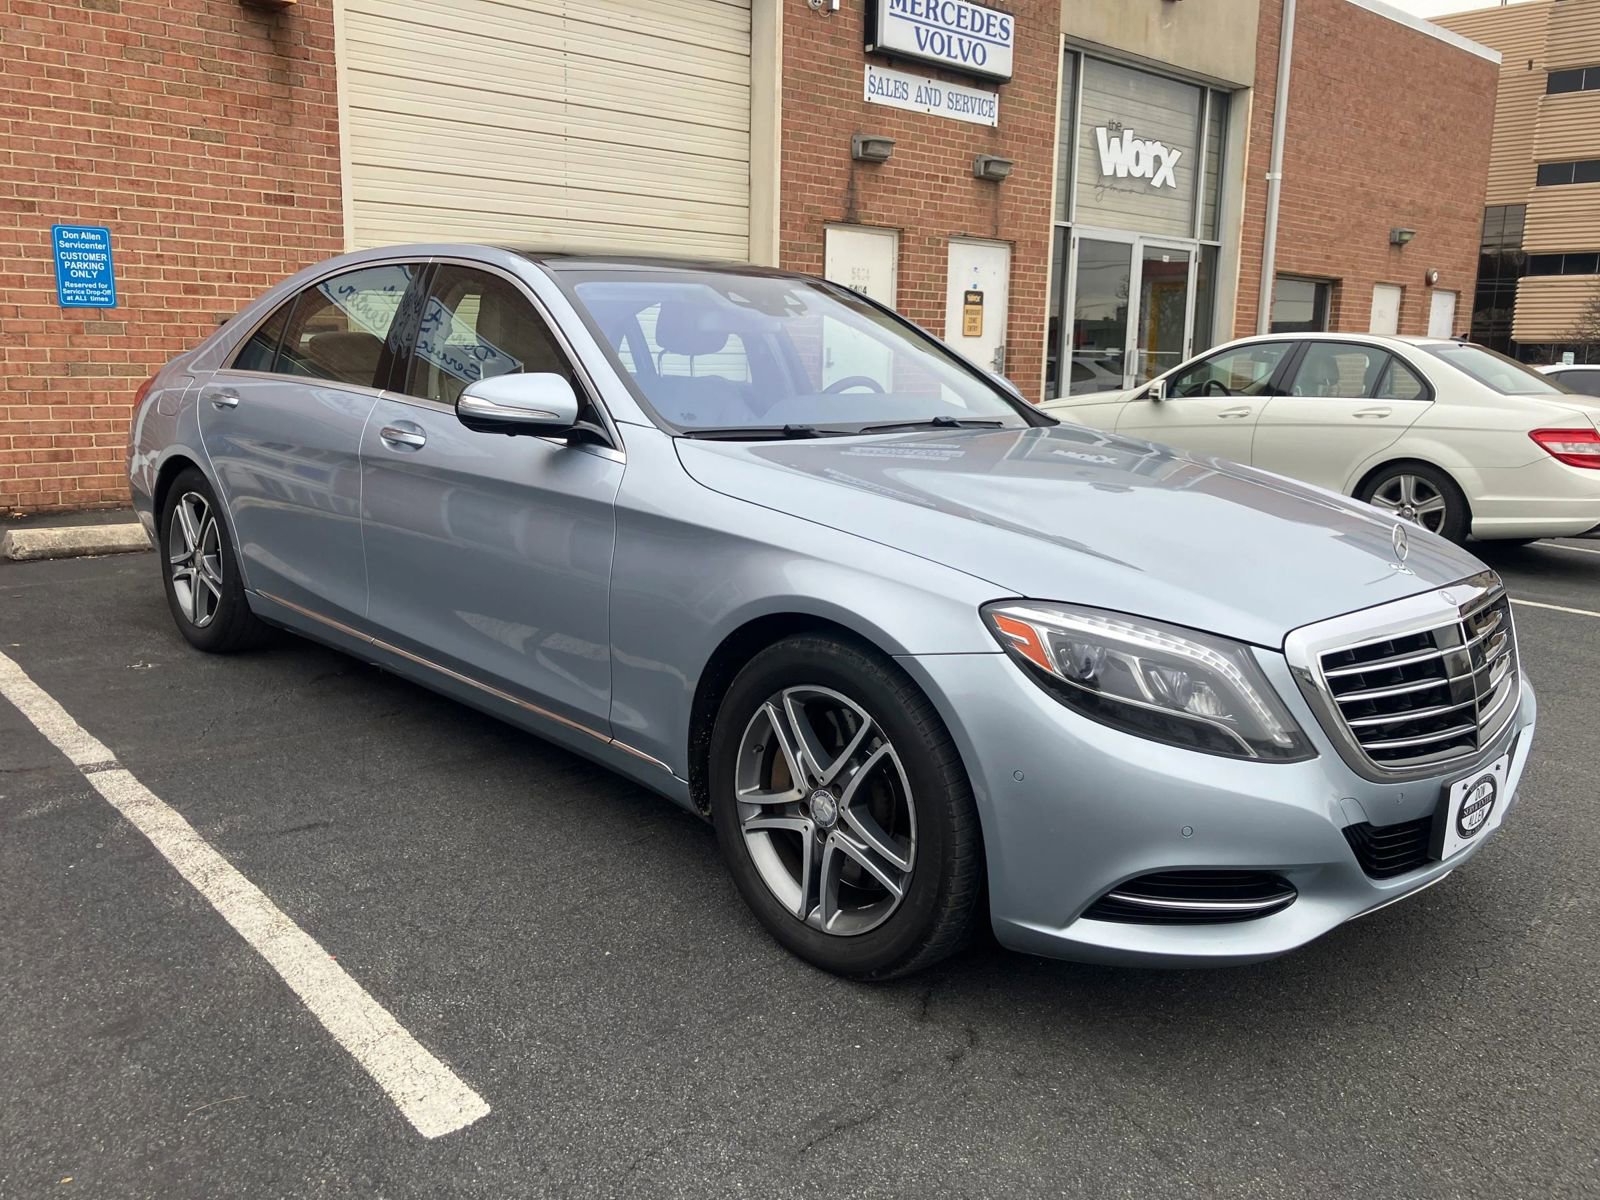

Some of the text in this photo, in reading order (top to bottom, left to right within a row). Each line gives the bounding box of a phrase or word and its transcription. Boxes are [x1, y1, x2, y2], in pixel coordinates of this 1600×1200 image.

[914, 26, 987, 66] VOLVO
[868, 74, 995, 118] SALES AND SERVICE
[62, 230, 101, 240] Don Allen
[59, 240, 106, 250] Servicenter
[60, 251, 107, 261] CUSTOMER
[64, 261, 105, 270] PARKING
[70, 270, 98, 278] ONLY
[1475, 784, 1487, 801] DON
[1468, 808, 1486, 828] ALLEN
